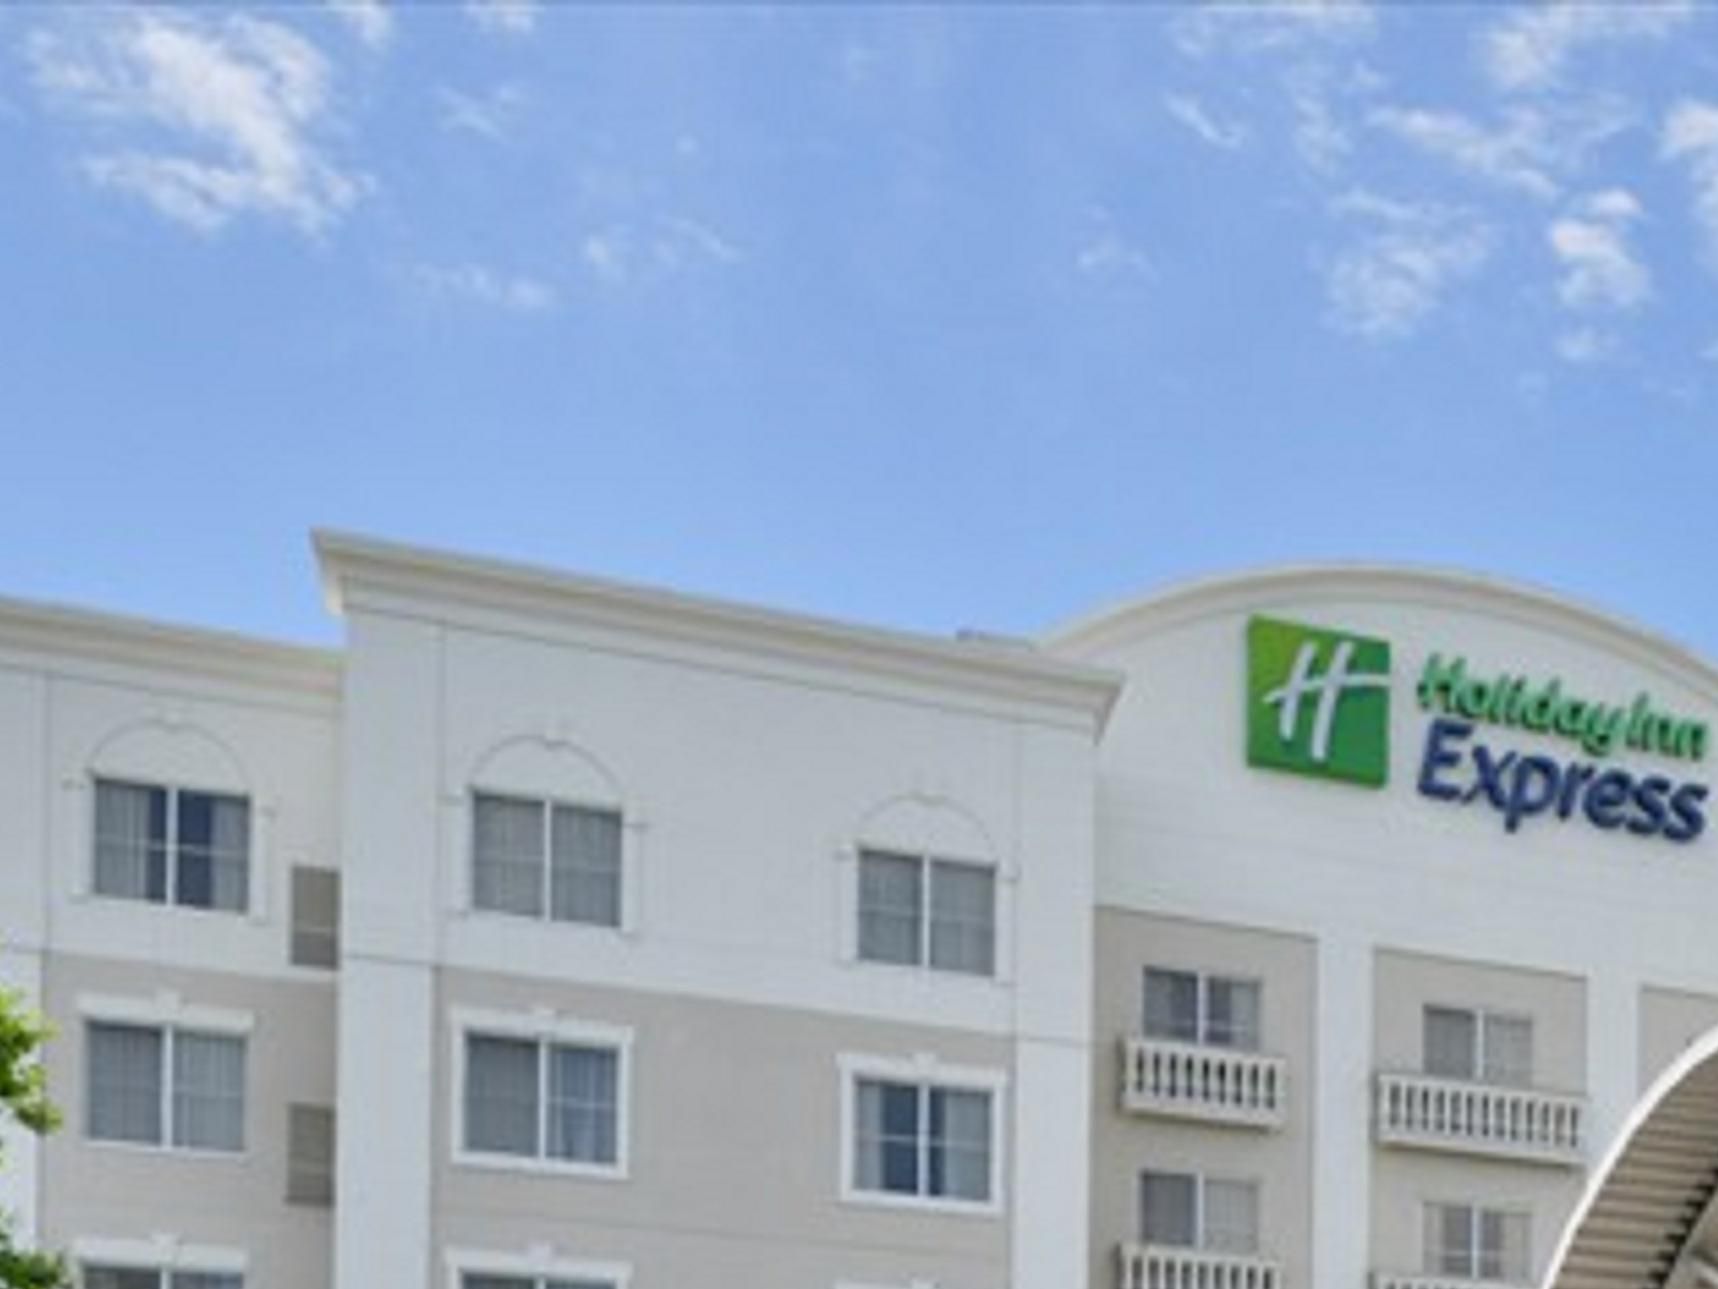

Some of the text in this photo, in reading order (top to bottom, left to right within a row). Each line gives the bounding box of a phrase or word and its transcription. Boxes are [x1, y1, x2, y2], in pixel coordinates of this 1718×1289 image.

[1416, 651, 1708, 762] Holiday Inn
[1417, 717, 1709, 844] Express
